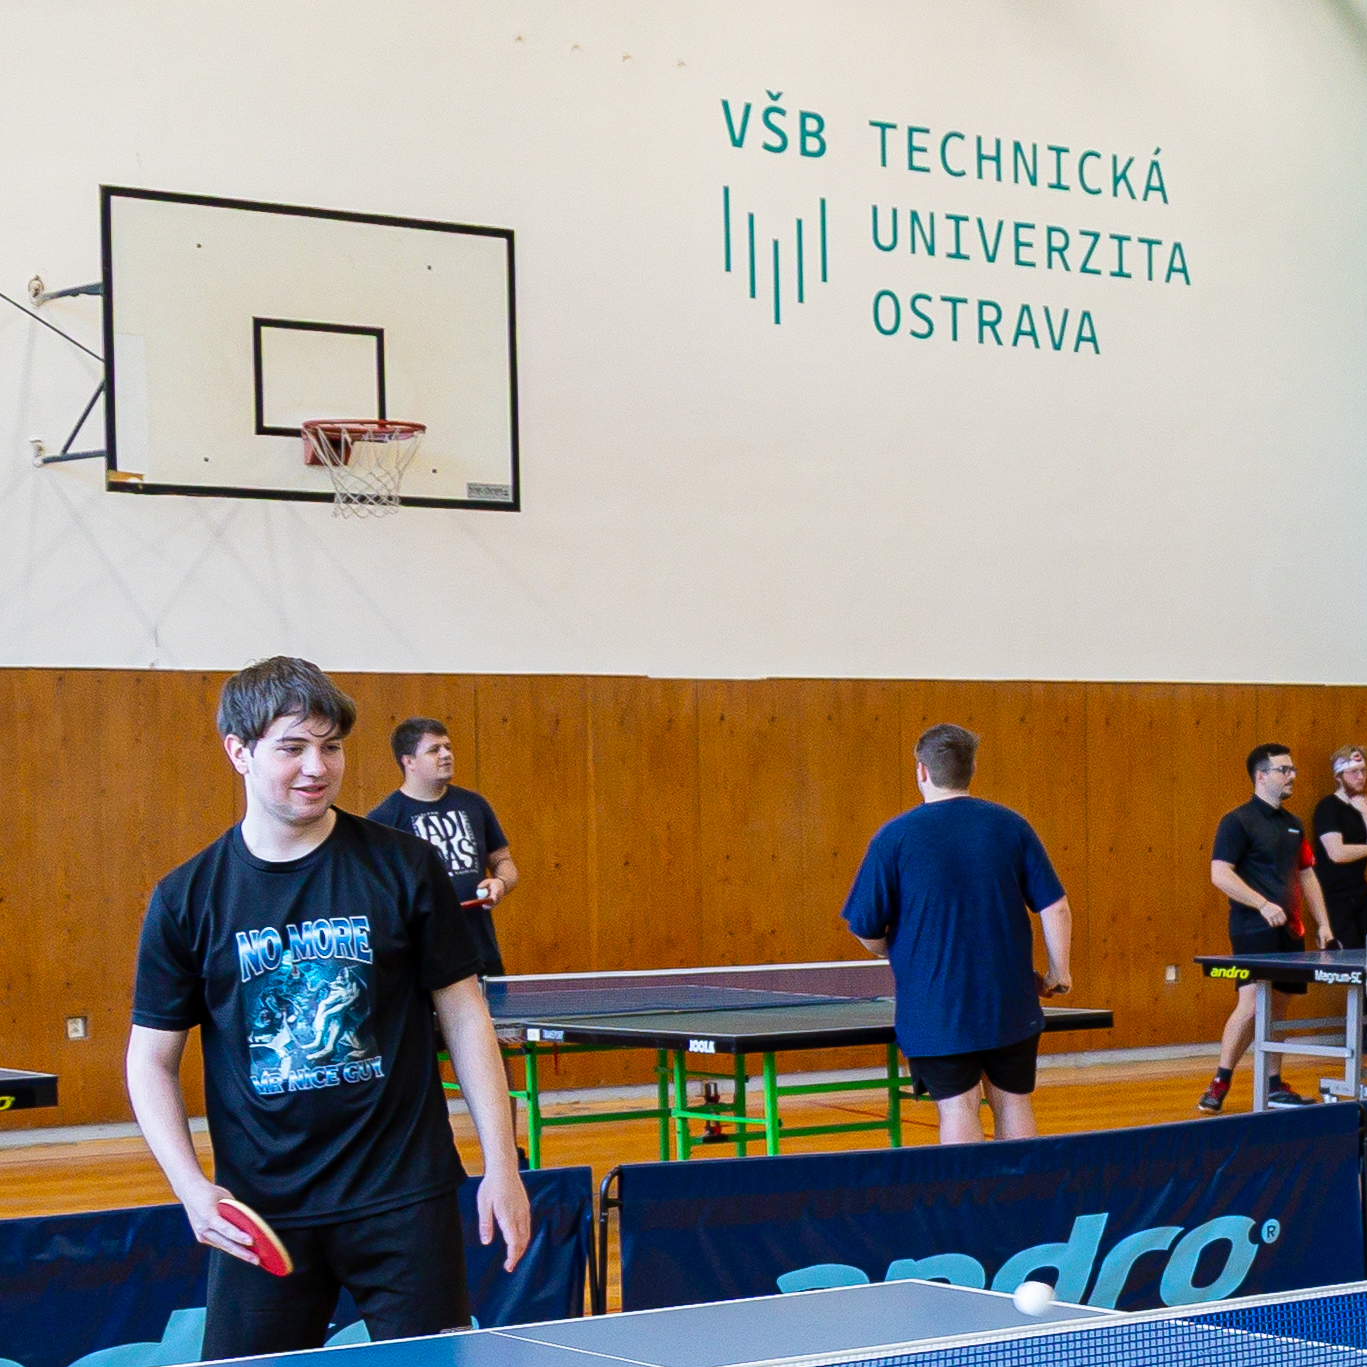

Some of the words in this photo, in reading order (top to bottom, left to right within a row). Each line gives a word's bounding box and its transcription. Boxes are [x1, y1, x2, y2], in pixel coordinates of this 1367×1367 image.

[720, 88, 828, 160] VŠB
[868, 119, 1170, 206] TECHNICKÁ
[870, 203, 1192, 286] UNIVERZITA
[872, 288, 1102, 355] OSTRAVA
[236, 926, 284, 983] NO
[286, 915, 374, 965] MORE
[1210, 967, 1249, 979] andro
[287, 1064, 340, 1092] NICE
[343, 1055, 385, 1083] GUY
